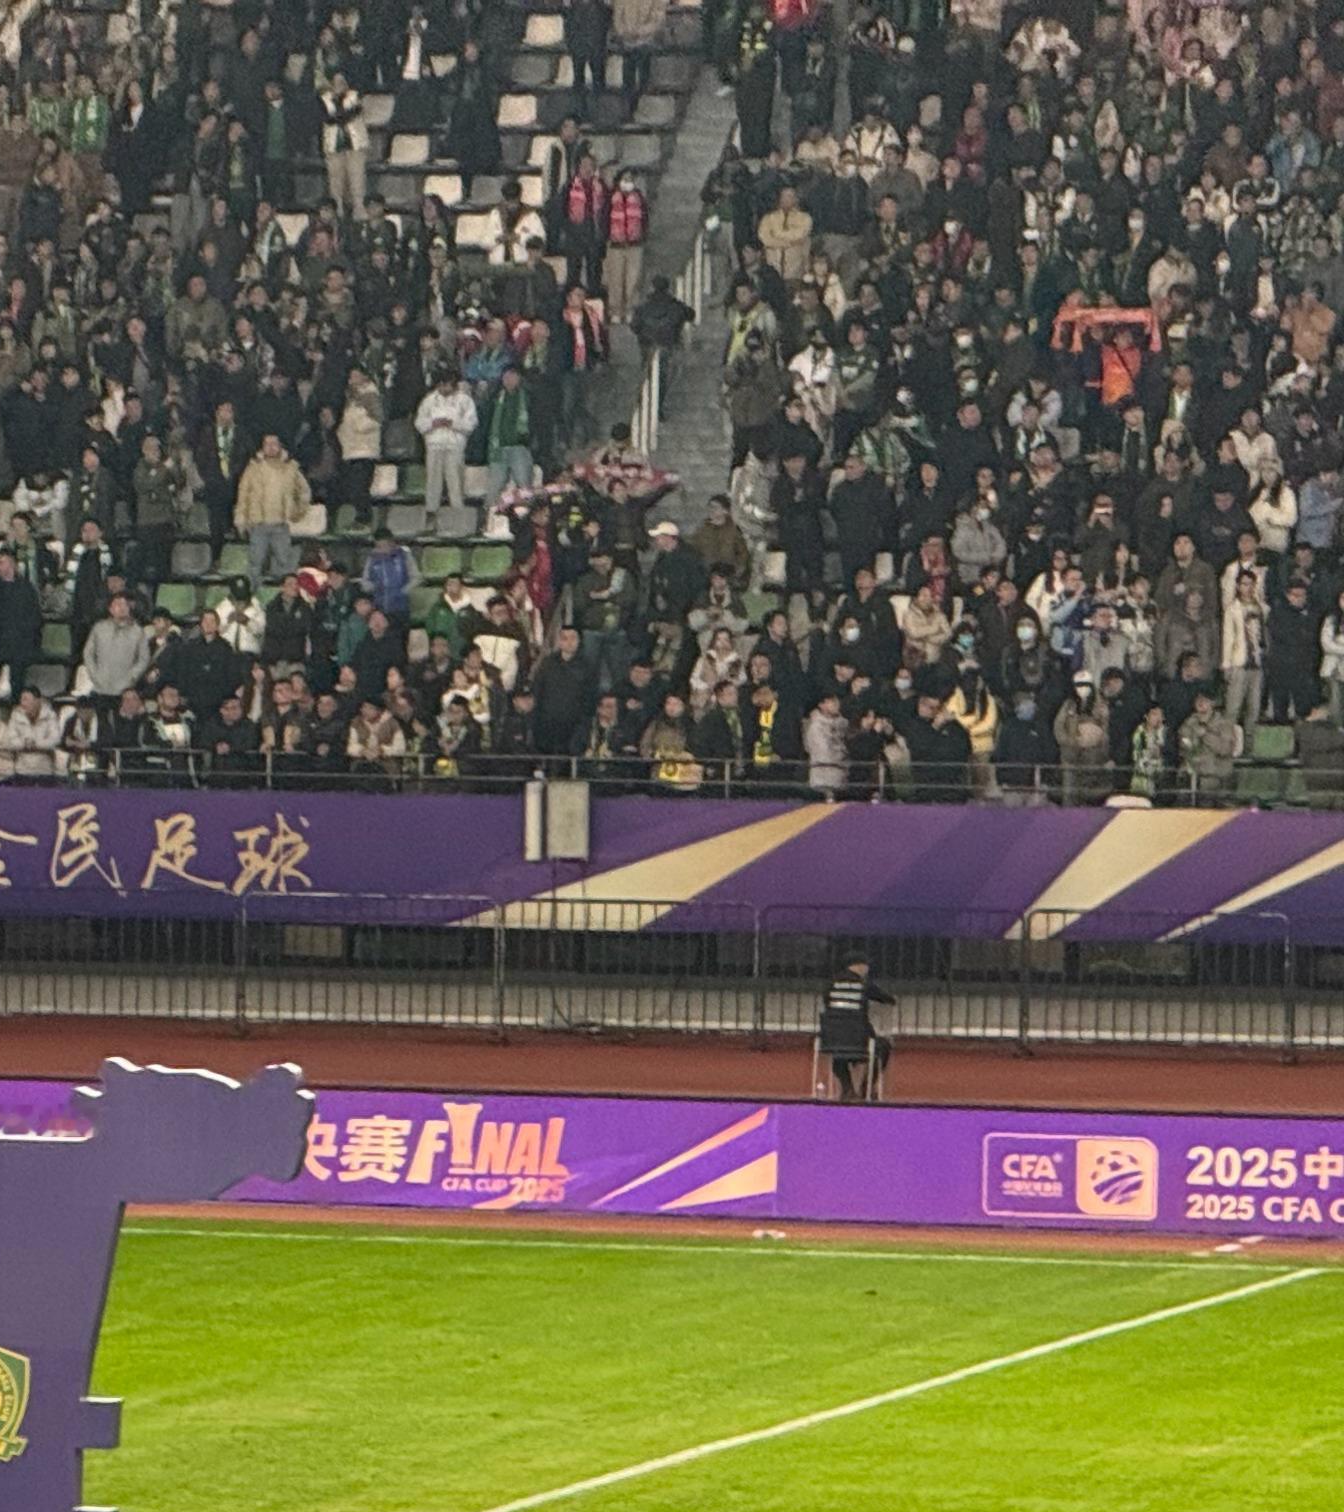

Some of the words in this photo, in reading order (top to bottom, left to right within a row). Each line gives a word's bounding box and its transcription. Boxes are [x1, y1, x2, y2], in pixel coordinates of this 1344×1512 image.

[1002, 1153, 1058, 1180] CFA
[1185, 1194, 1256, 1221] 2025
[1262, 1196, 1323, 1223] CFA
